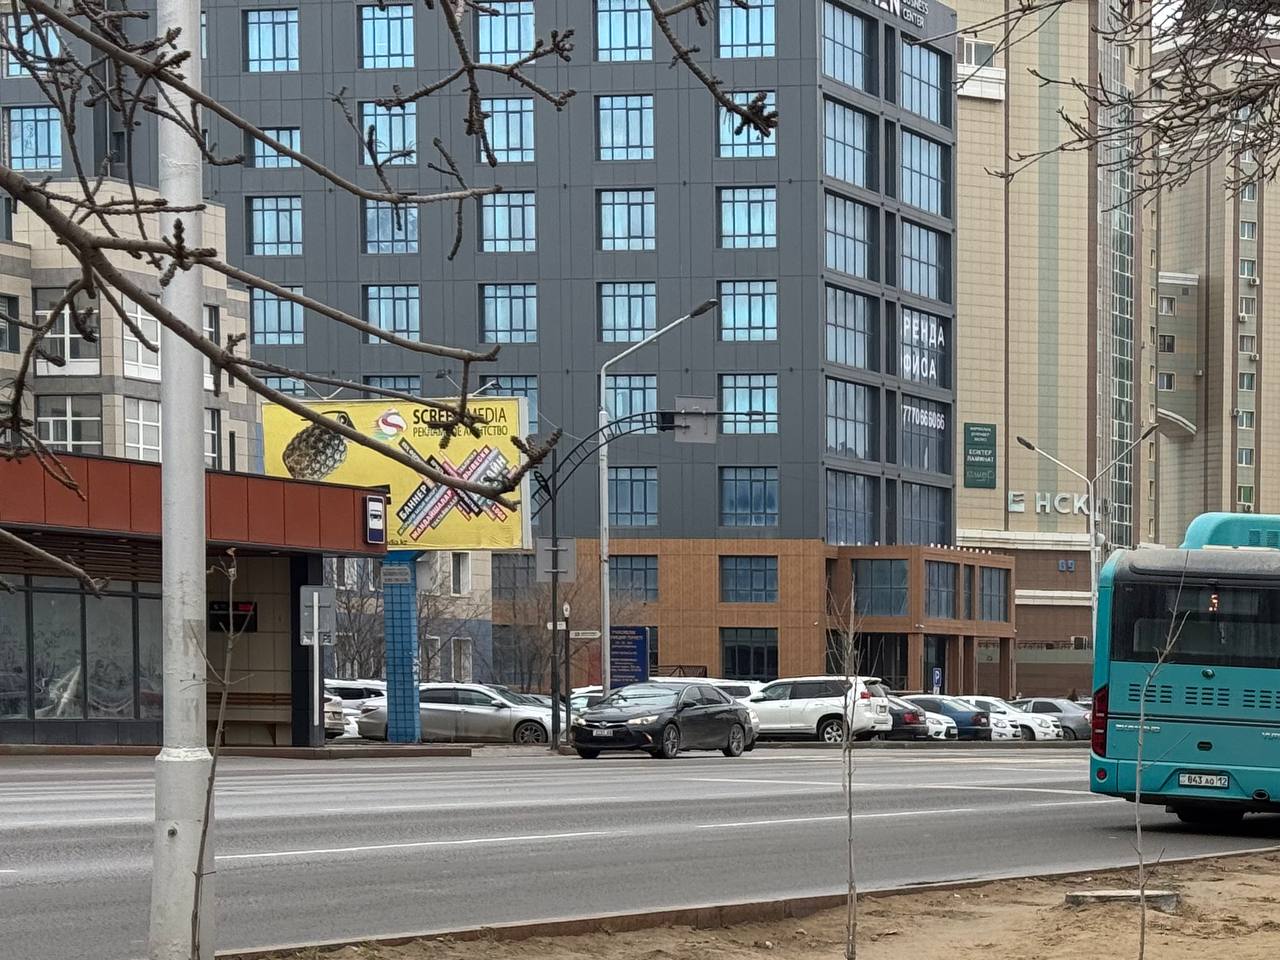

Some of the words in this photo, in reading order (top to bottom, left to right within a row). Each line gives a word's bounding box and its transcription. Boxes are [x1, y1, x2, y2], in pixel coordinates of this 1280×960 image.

[903, 8, 925, 28] CENTER
[903, 316, 945, 348] РЕНДА
[903, 353, 937, 380] ФИСА
[398, 484, 429, 520] БАННЕР
[1187, 775, 1203, 785] 843
[1217, 777, 1228, 786] 12
